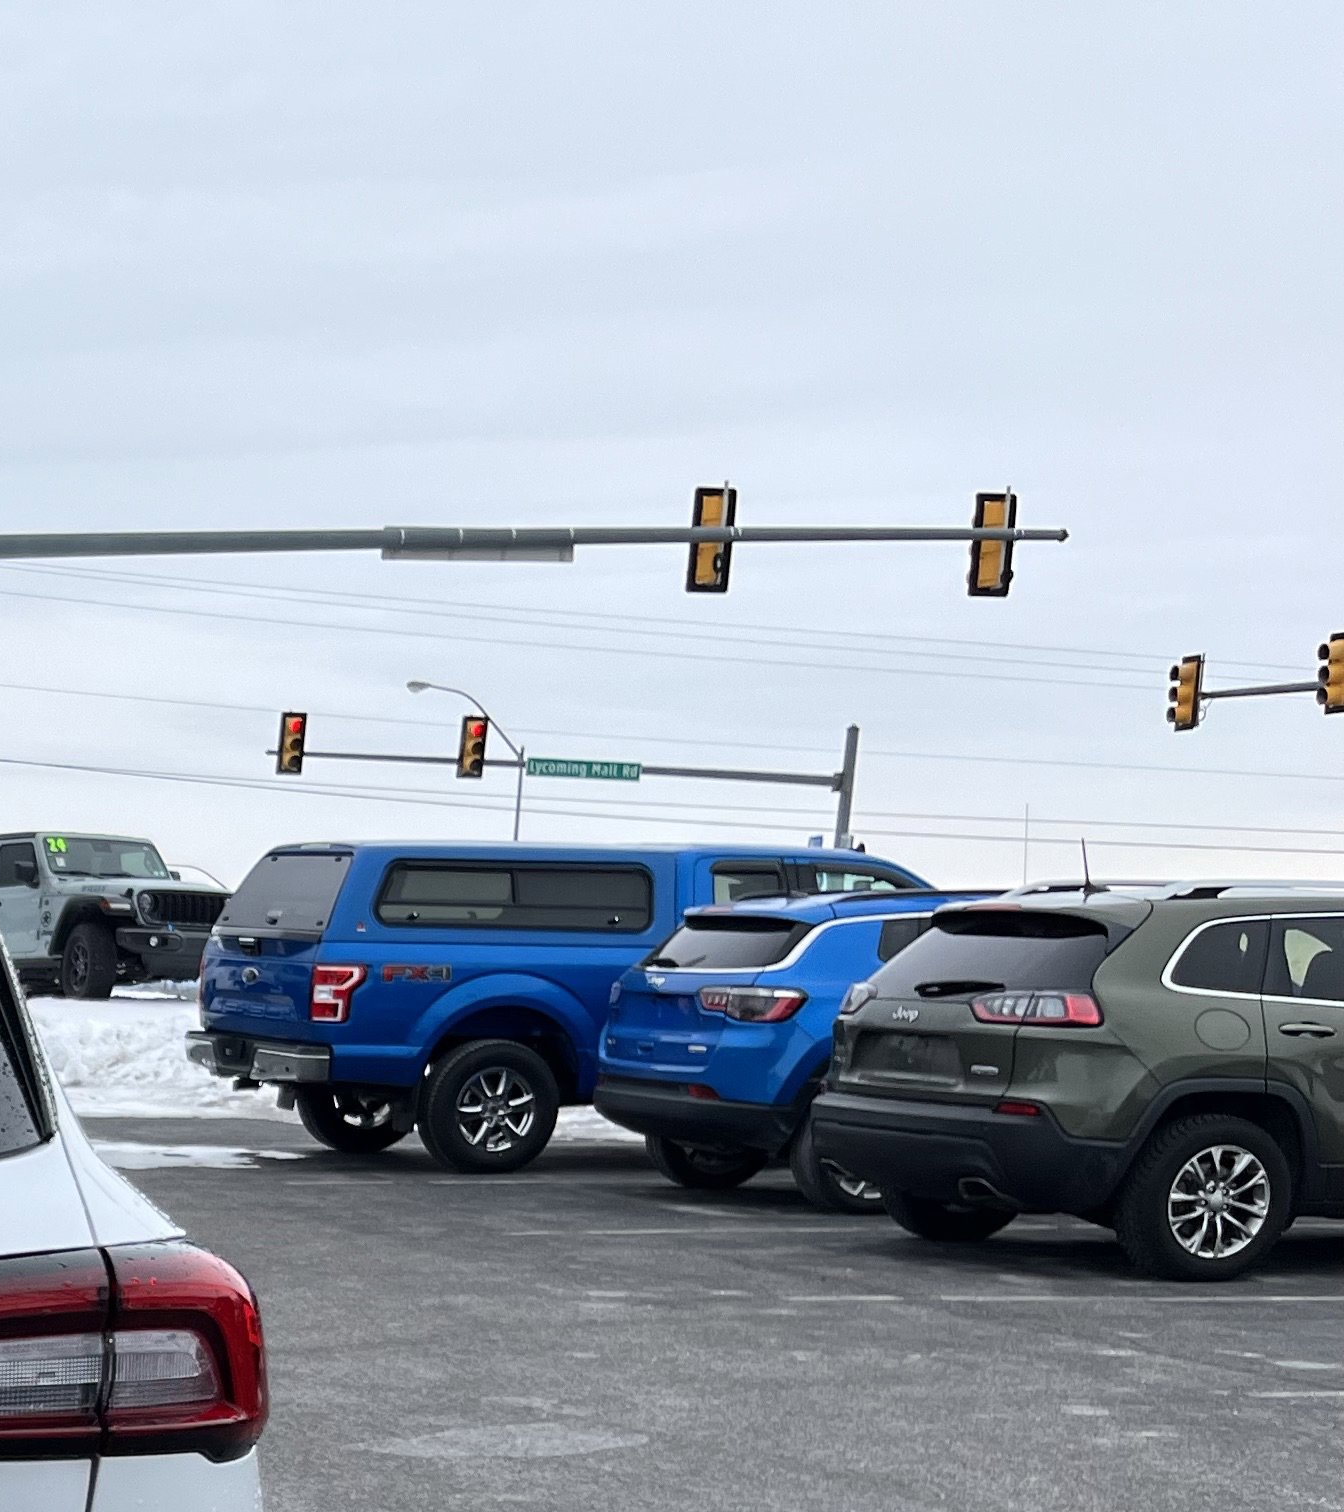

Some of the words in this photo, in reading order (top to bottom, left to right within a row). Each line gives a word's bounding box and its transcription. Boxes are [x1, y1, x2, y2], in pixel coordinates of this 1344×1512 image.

[529, 759, 587, 778] Lycoming
[591, 763, 618, 777] Mall
[622, 765, 638, 778] Rd
[382, 964, 452, 982] FX4
